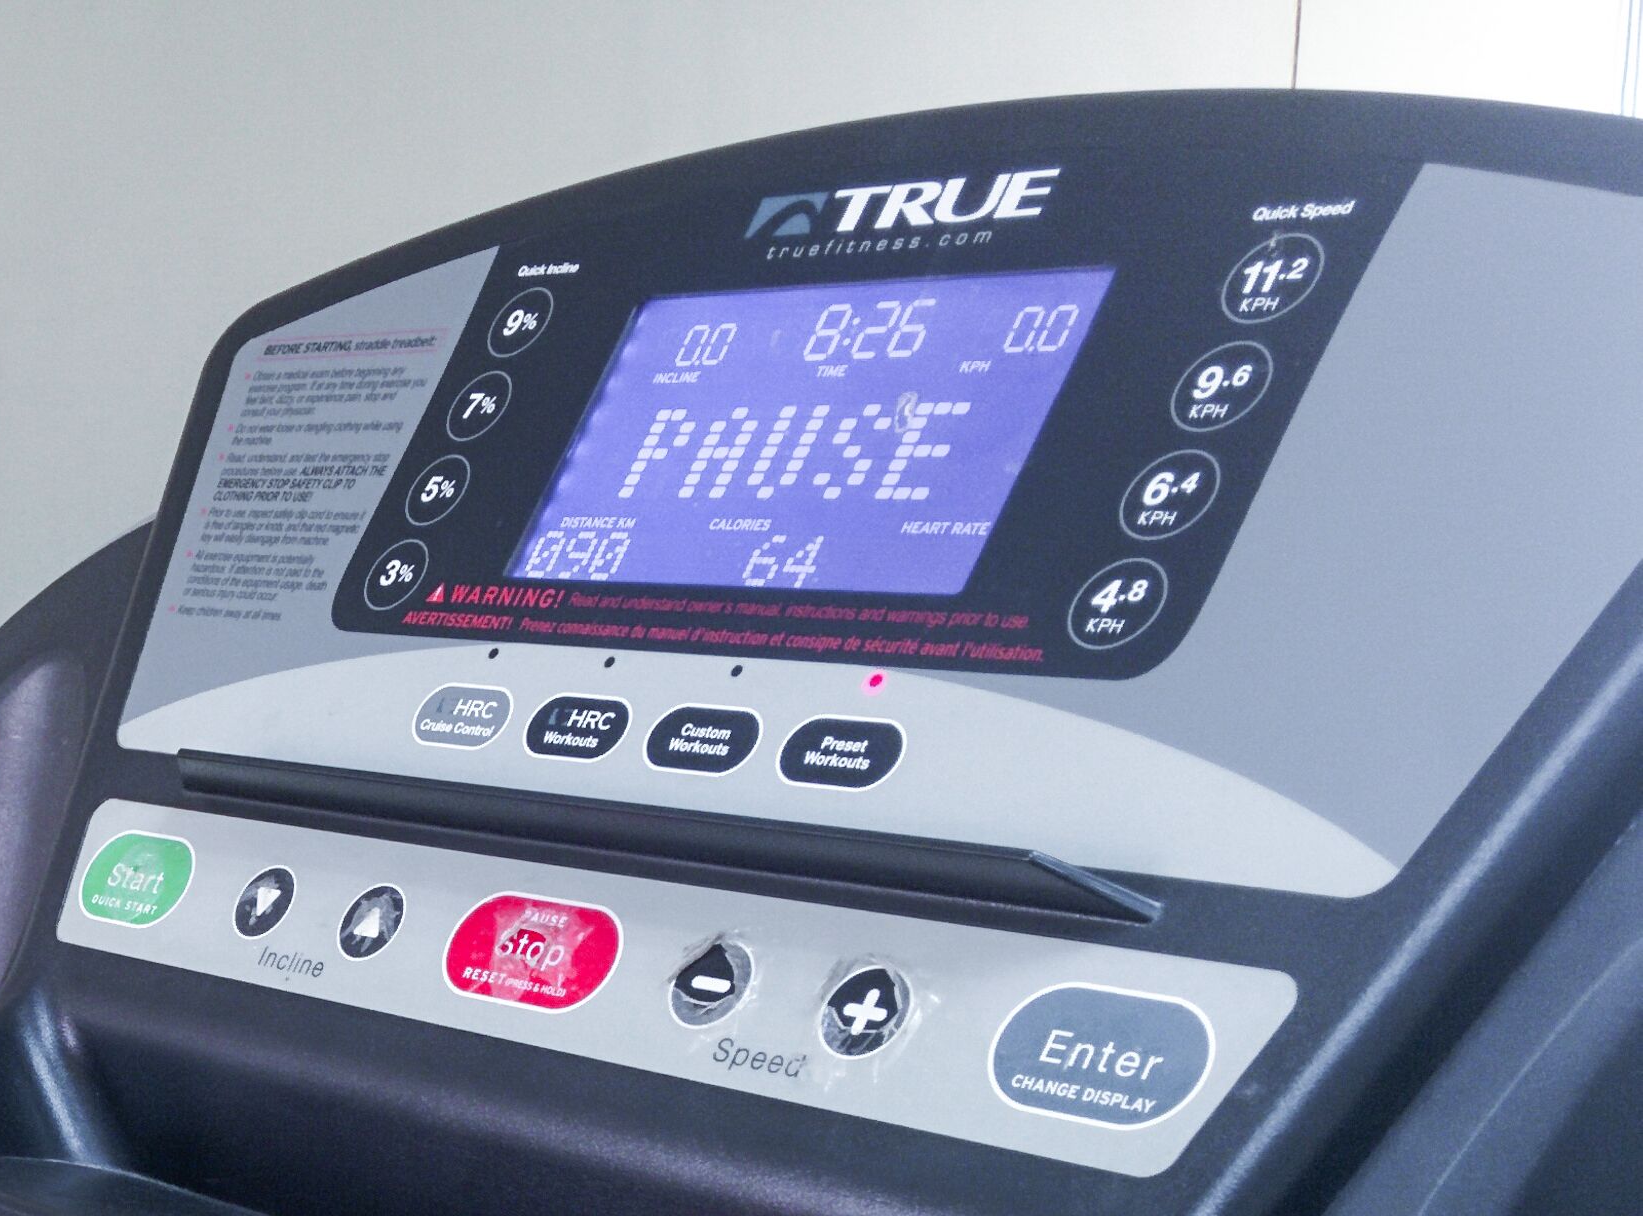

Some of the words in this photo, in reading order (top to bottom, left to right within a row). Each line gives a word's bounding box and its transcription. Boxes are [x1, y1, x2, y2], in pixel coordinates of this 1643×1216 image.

[835, 168, 1061, 232] TRUE
[1252, 205, 1299, 221] Quick
[1300, 199, 1356, 220] Speed
[766, 229, 994, 259] truefitness.com
[518, 264, 546, 277] Quick
[546, 262, 580, 275] Incline
[1242, 257, 1310, 294] 11.2
[1239, 297, 1280, 312] KPH
[503, 309, 539, 336] 9%
[803, 299, 937, 361] 8:26
[1003, 304, 1079, 353] 0.0
[264, 344, 303, 356] BEFORE
[675, 323, 737, 367] 0.0
[653, 371, 702, 384] INCLINE
[816, 364, 848, 378] TIME
[959, 360, 992, 374] KPH
[1192, 364, 1253, 400] 9.6
[462, 392, 496, 419] 7%
[1188, 403, 1229, 419] KPH
[618, 401, 971, 500] PAUSE
[300, 465, 334, 476] ALWAYS
[334, 465, 368, 476] ATTACH
[370, 466, 388, 476] THE
[217, 478, 266, 489] EMERGENCY
[266, 478, 290, 489] STOP
[289, 478, 323, 489] SAFETY
[323, 479, 343, 489] CLIP
[343, 479, 357, 489] TO
[421, 476, 455, 503] 5%
[1143, 472, 1200, 506] 6.4
[213, 491, 254, 501] CLOTHING
[254, 491, 280, 501] PRIOR
[281, 491, 293, 501] TO
[560, 516, 617, 528] DISTANCE
[616, 517, 637, 529] KM
[709, 518, 772, 532] CALORIES
[901, 520, 949, 535] HEART
[951, 521, 991, 536] RATE
[1138, 511, 1177, 526] KPH
[742, 534, 824, 588] 64
[379, 559, 415, 587] 3%
[450, 584, 566, 609] WARNING!
[1091, 578, 1149, 614] 4.8
[402, 611, 515, 630] AVERTISSEMENT!
[519, 617, 556, 633] Prenez
[557, 620, 630, 638] connaissance
[631, 624, 646, 638] du
[647, 626, 690, 641] manuel
[691, 627, 769, 646] d'instruction
[770, 631, 785, 646] et
[786, 633, 843, 652] consigne
[844, 636, 861, 651] de
[864, 636, 921, 655] sécurité
[920, 641, 961, 657] avant
[1086, 618, 1126, 633] KPH
[453, 698, 498, 719] HRC
[420, 719, 453, 733] Cruise
[454, 722, 495, 738] Control
[567, 709, 616, 731] HRC
[543, 731, 599, 748] Workouts
[681, 722, 732, 741] Custom
[669, 737, 730, 756] Workouts
[821, 735, 869, 753] Preset
[804, 751, 870, 771] Workouts
[107, 862, 165, 895] Start
[91, 894, 122, 909] QUICK
[124, 900, 158, 915] START
[524, 910, 568, 928] PAUSE
[257, 946, 325, 978] Incline
[462, 966, 507, 985] RESET
[713, 1037, 808, 1078] Speed
[1039, 1029, 1165, 1081] Enter
[1011, 1073, 1081, 1100] CHANGE
[1082, 1087, 1157, 1114] DISPLAY
